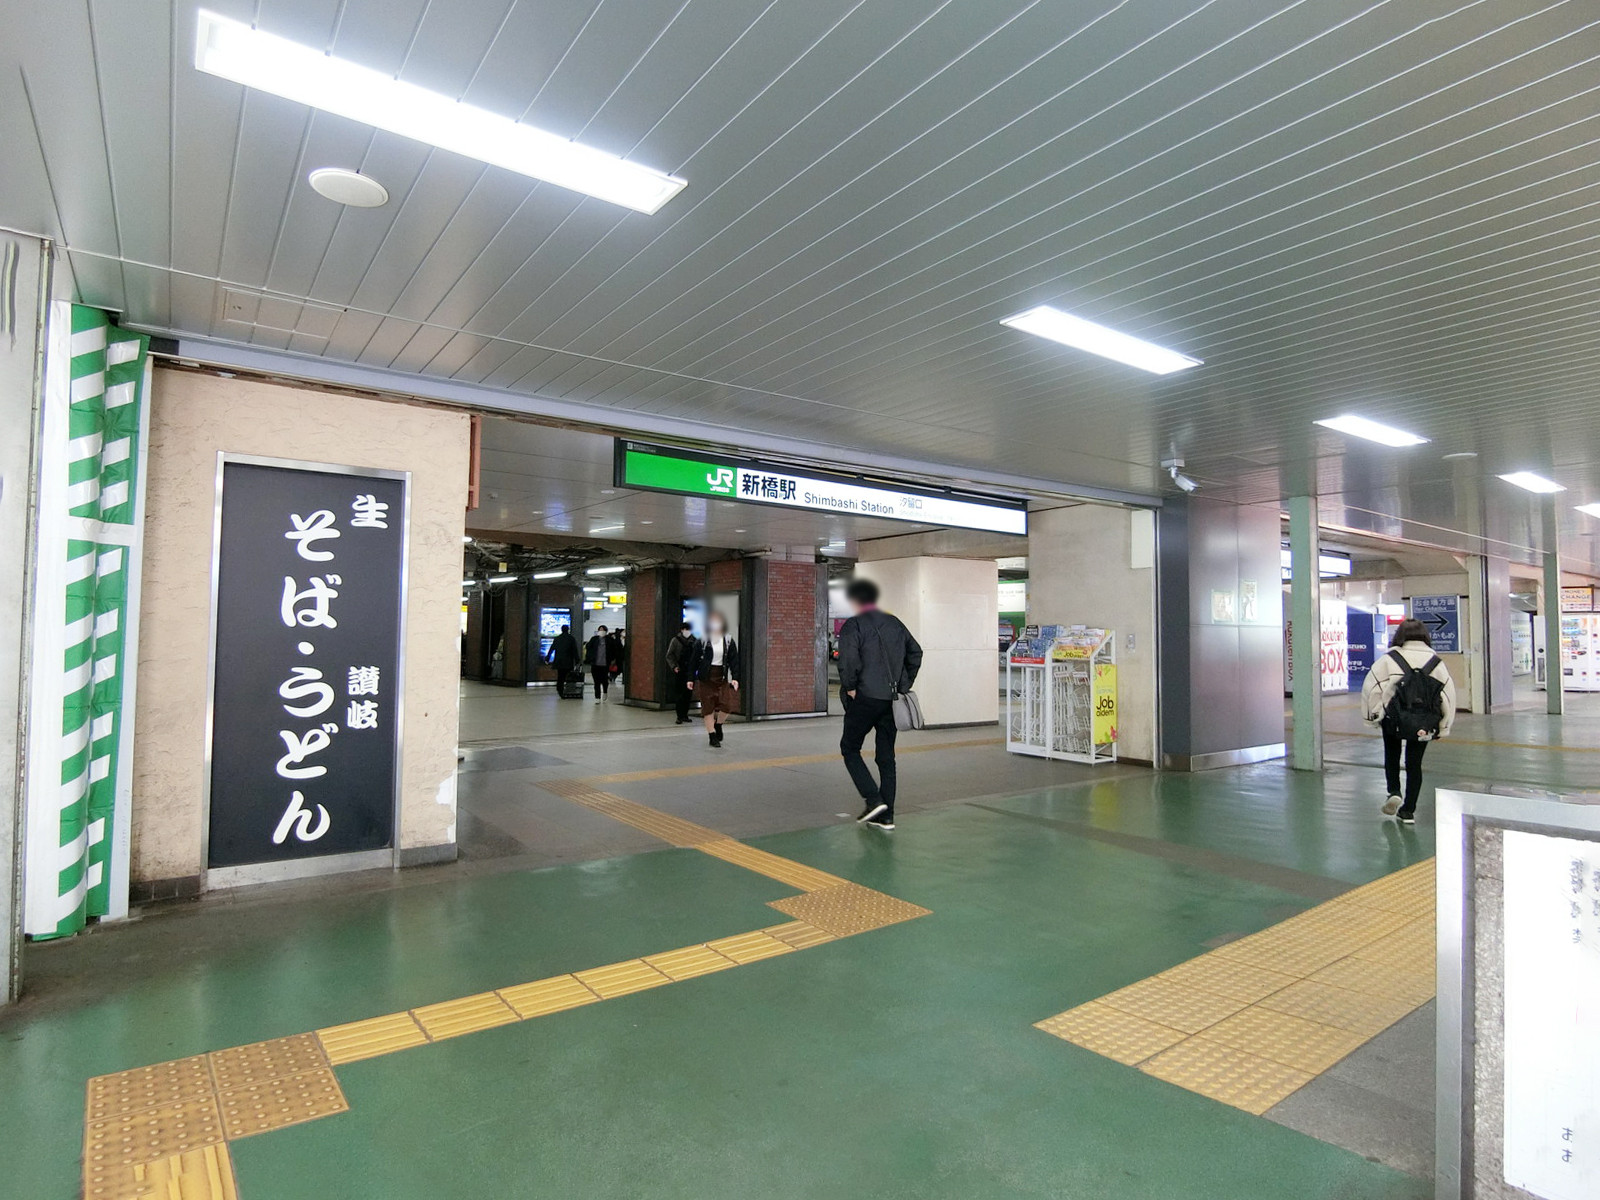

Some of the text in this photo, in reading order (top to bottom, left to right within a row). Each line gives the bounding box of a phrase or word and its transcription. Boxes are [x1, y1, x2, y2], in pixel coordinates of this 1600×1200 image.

[706, 468, 734, 488] JR
[741, 472, 797, 501] 新橋駅
[350, 494, 390, 530] 生
[804, 491, 895, 515] Shimbashi Station
[1320, 628, 1345, 642] akuten
[1320, 648, 1345, 675] BOX
[273, 509, 344, 845] そば・うどん
[1095, 695, 1115, 710] Job
